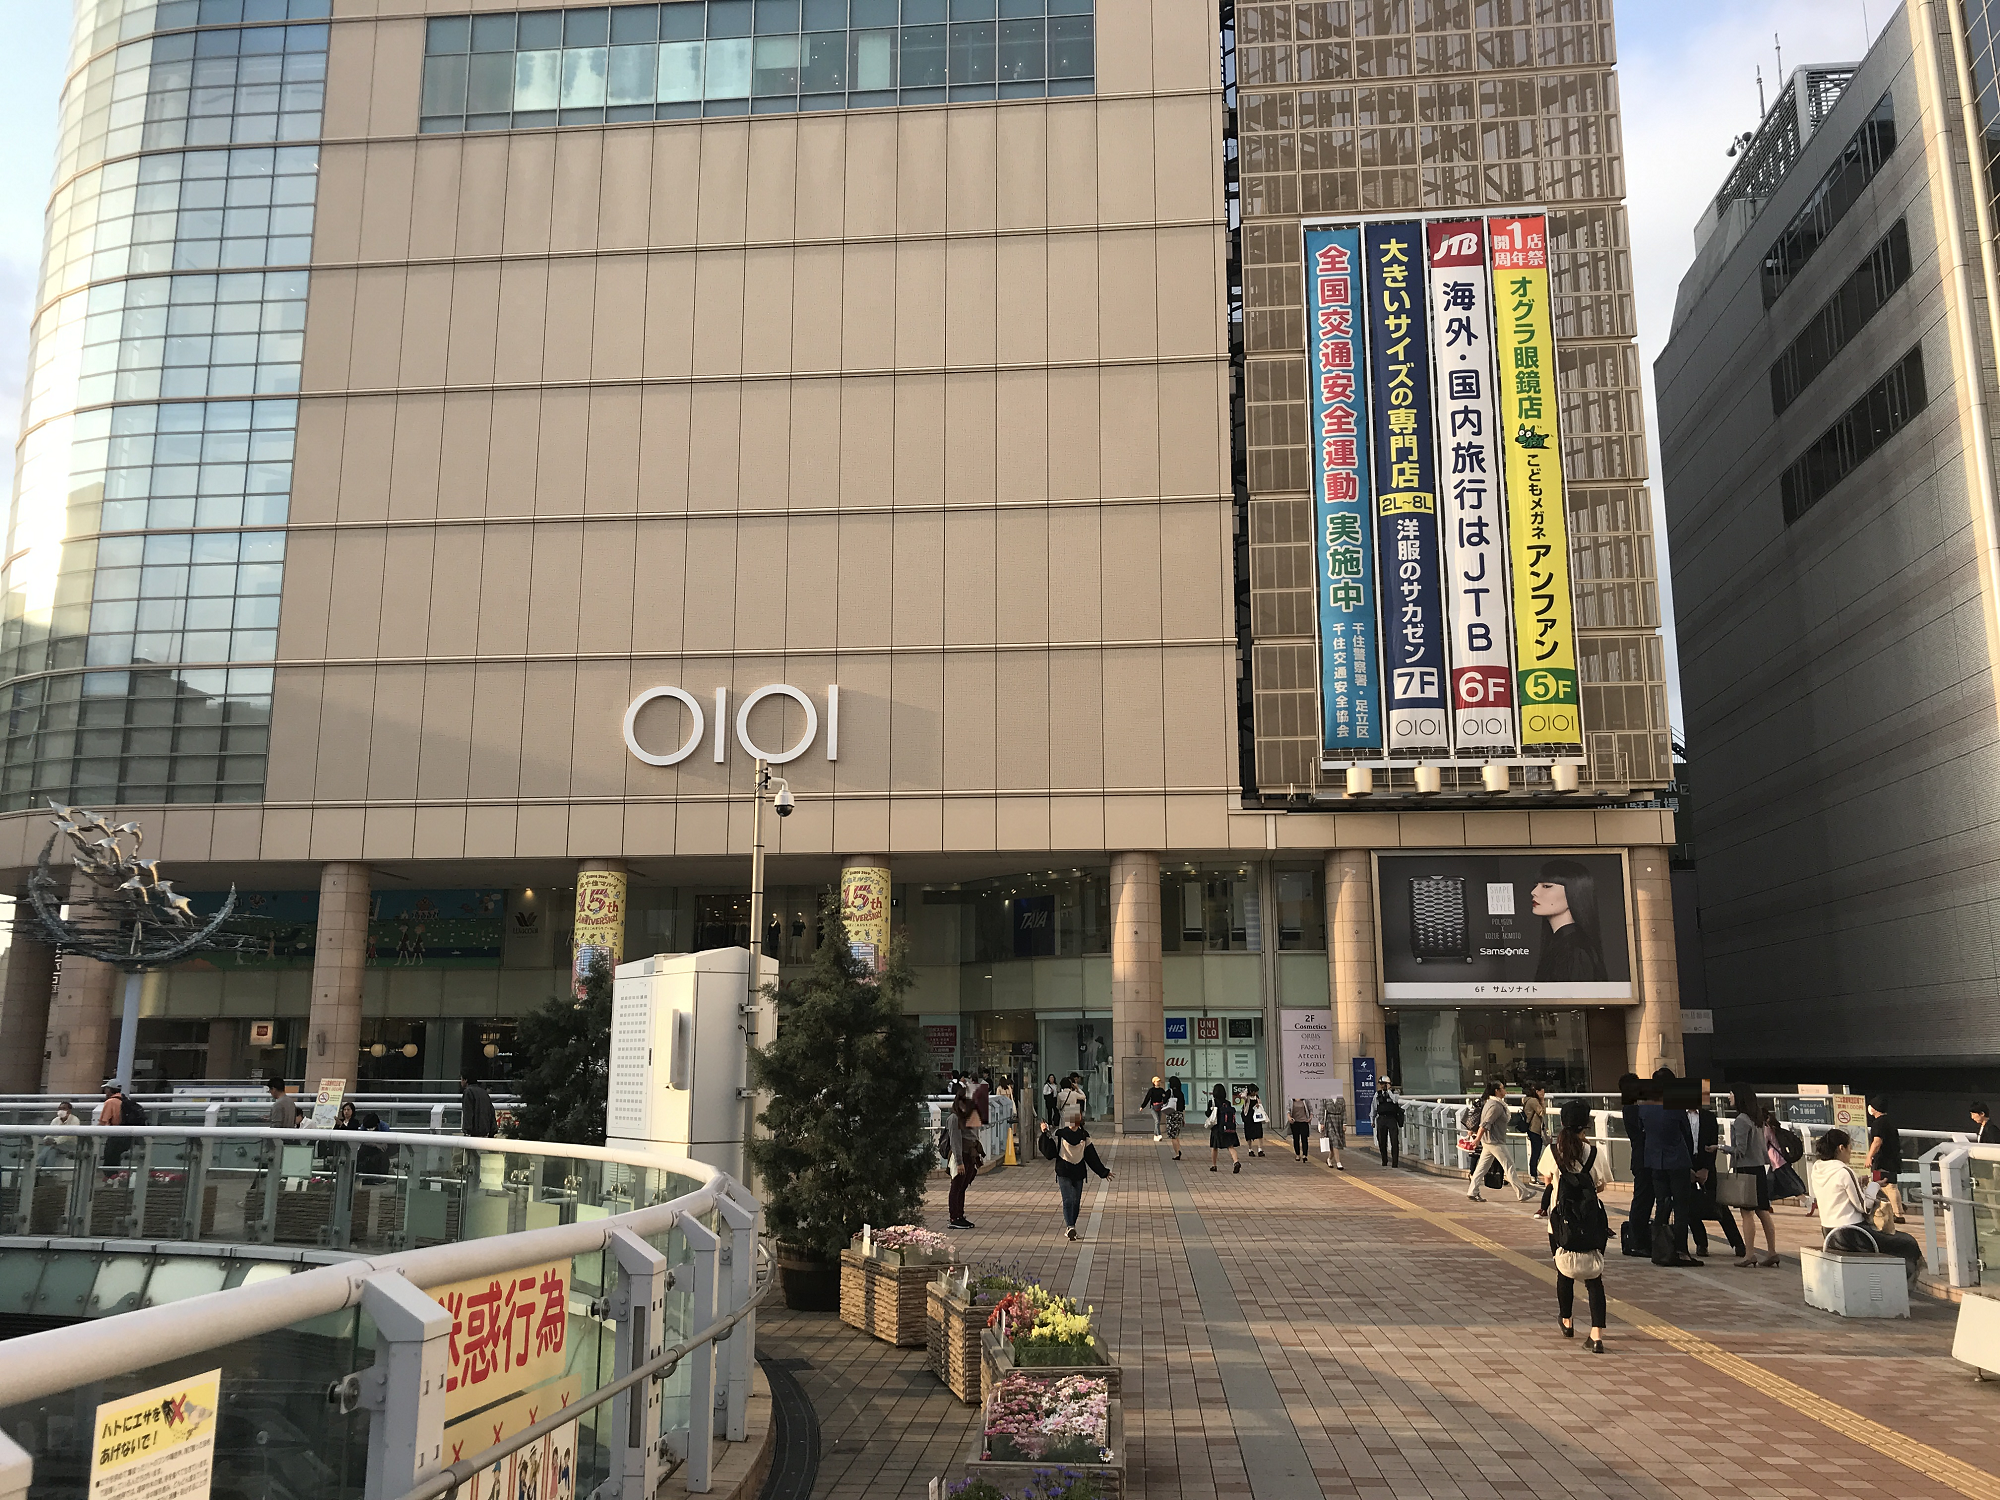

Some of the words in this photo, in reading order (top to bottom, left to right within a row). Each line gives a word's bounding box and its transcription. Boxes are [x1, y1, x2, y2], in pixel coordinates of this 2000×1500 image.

[1433, 232, 1479, 261] JTB
[1510, 276, 1543, 420] オグラ眼鏡店
[1315, 244, 1359, 503] 全国交通安全運動
[1379, 238, 1421, 489] 大きいサイズの専門店
[1442, 281, 1494, 652] 海外・国内旅行はJTB
[1526, 454, 1547, 540] こどもメガネ
[1326, 511, 1366, 613] 実施中
[1396, 518, 1426, 664] 洋服のサカゼン
[1526, 544, 1560, 661] アンファン
[1332, 622, 1349, 738] 千住交通安全協会
[1352, 622, 1369, 739] 千住警察署・足立区
[1396, 671, 1436, 696] 7F
[1458, 671, 1506, 703] 6F
[1527, 671, 1572, 701] 5F
[579, 888, 619, 914] 15th
[1489, 886, 1510, 894] SHAPE
[1491, 895, 1512, 903] YOUR
[1020, 910, 1048, 929] TAYA
[1491, 904, 1512, 912] STYLE
[1479, 947, 1530, 956] Samsonite
[1474, 985, 1485, 993] 6F
[1492, 985, 1538, 993] サムソナイト
[1199, 1020, 1216, 1028] UNI
[1294, 1022, 1327, 1030] Cosmetics
[1305, 1014, 1315, 1022] 2F
[1199, 1029, 1217, 1038] QLO
[1166, 1057, 1188, 1067] au
[101, 1407, 162, 1439] ハトにエサを
